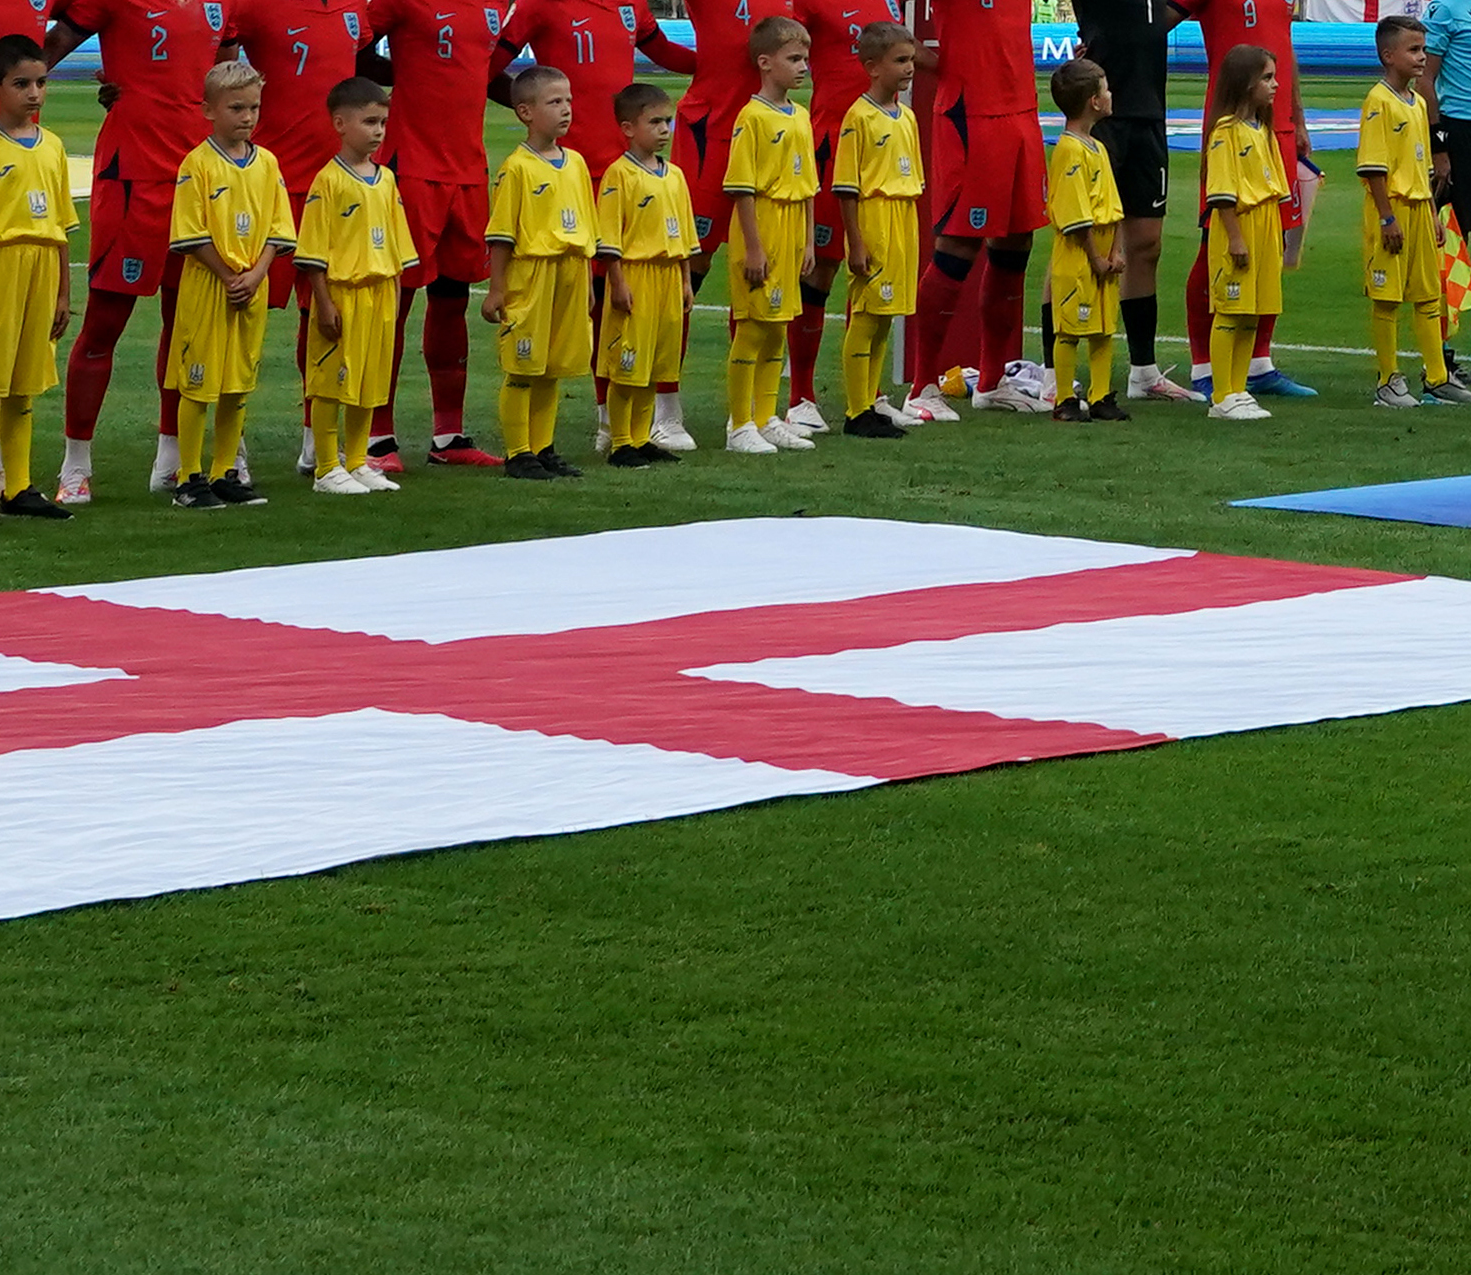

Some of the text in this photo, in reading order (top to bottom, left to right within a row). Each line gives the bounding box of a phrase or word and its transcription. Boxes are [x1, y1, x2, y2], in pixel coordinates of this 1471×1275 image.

[151, 25, 169, 61] 2
[291, 41, 309, 76] 7
[437, 24, 453, 59] 5
[572, 30, 594, 64] 11
[1159, 166, 1166, 197] 1
